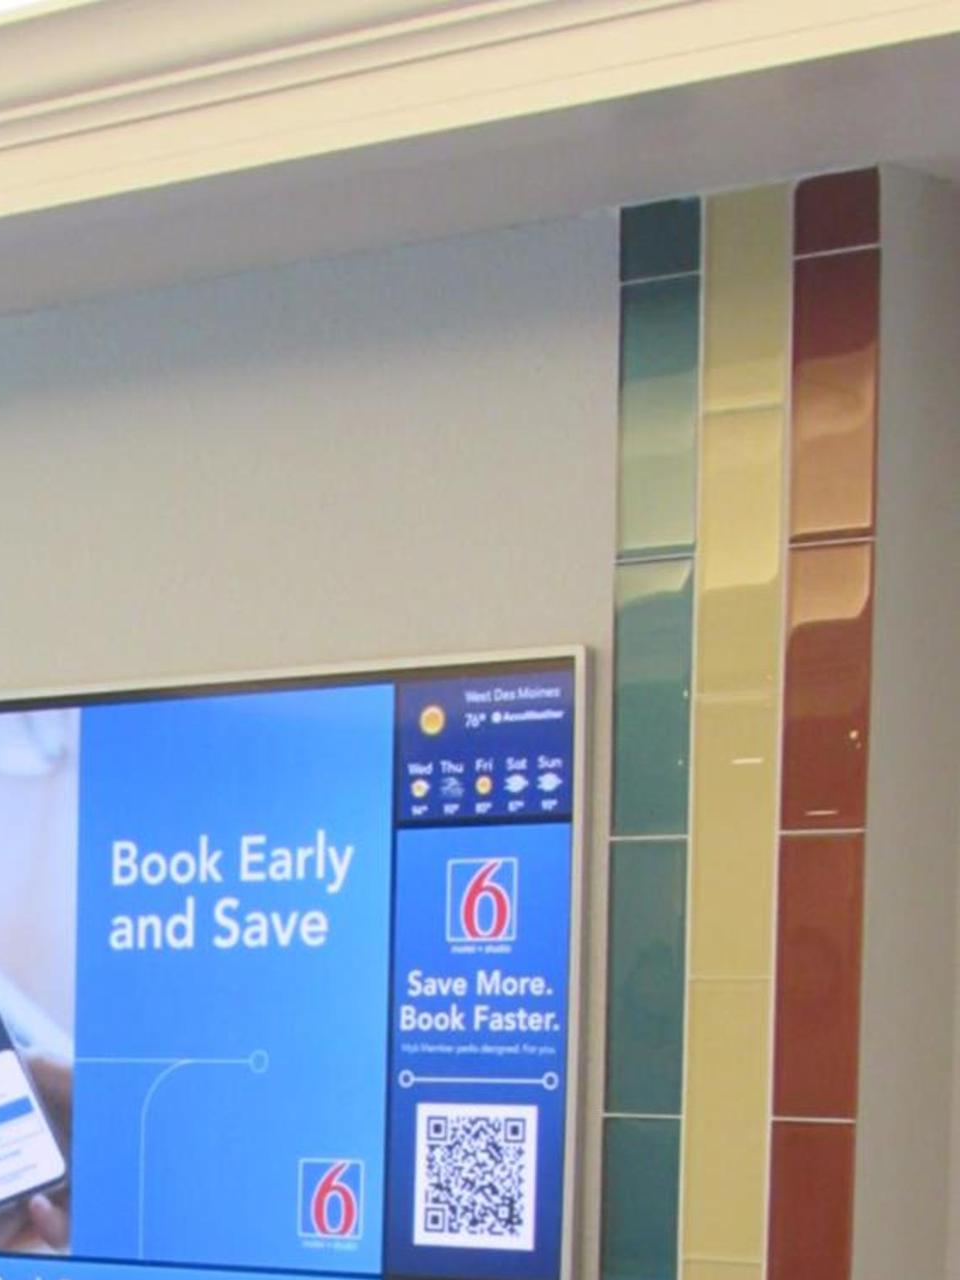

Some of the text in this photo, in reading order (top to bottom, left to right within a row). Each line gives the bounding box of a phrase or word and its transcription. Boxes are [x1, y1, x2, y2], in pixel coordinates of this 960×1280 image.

[408, 763, 433, 775] Wed
[440, 760, 464, 773] Thu
[475, 758, 493, 772] Fri
[507, 757, 527, 770] Sat
[538, 755, 562, 769] Sun
[112, 829, 355, 894] Book Early
[460, 859, 511, 941] 6
[109, 896, 329, 950] and Save
[407, 969, 553, 997] Save More.
[400, 1003, 560, 1031] Book Faster.
[311, 1161, 357, 1238] 6
